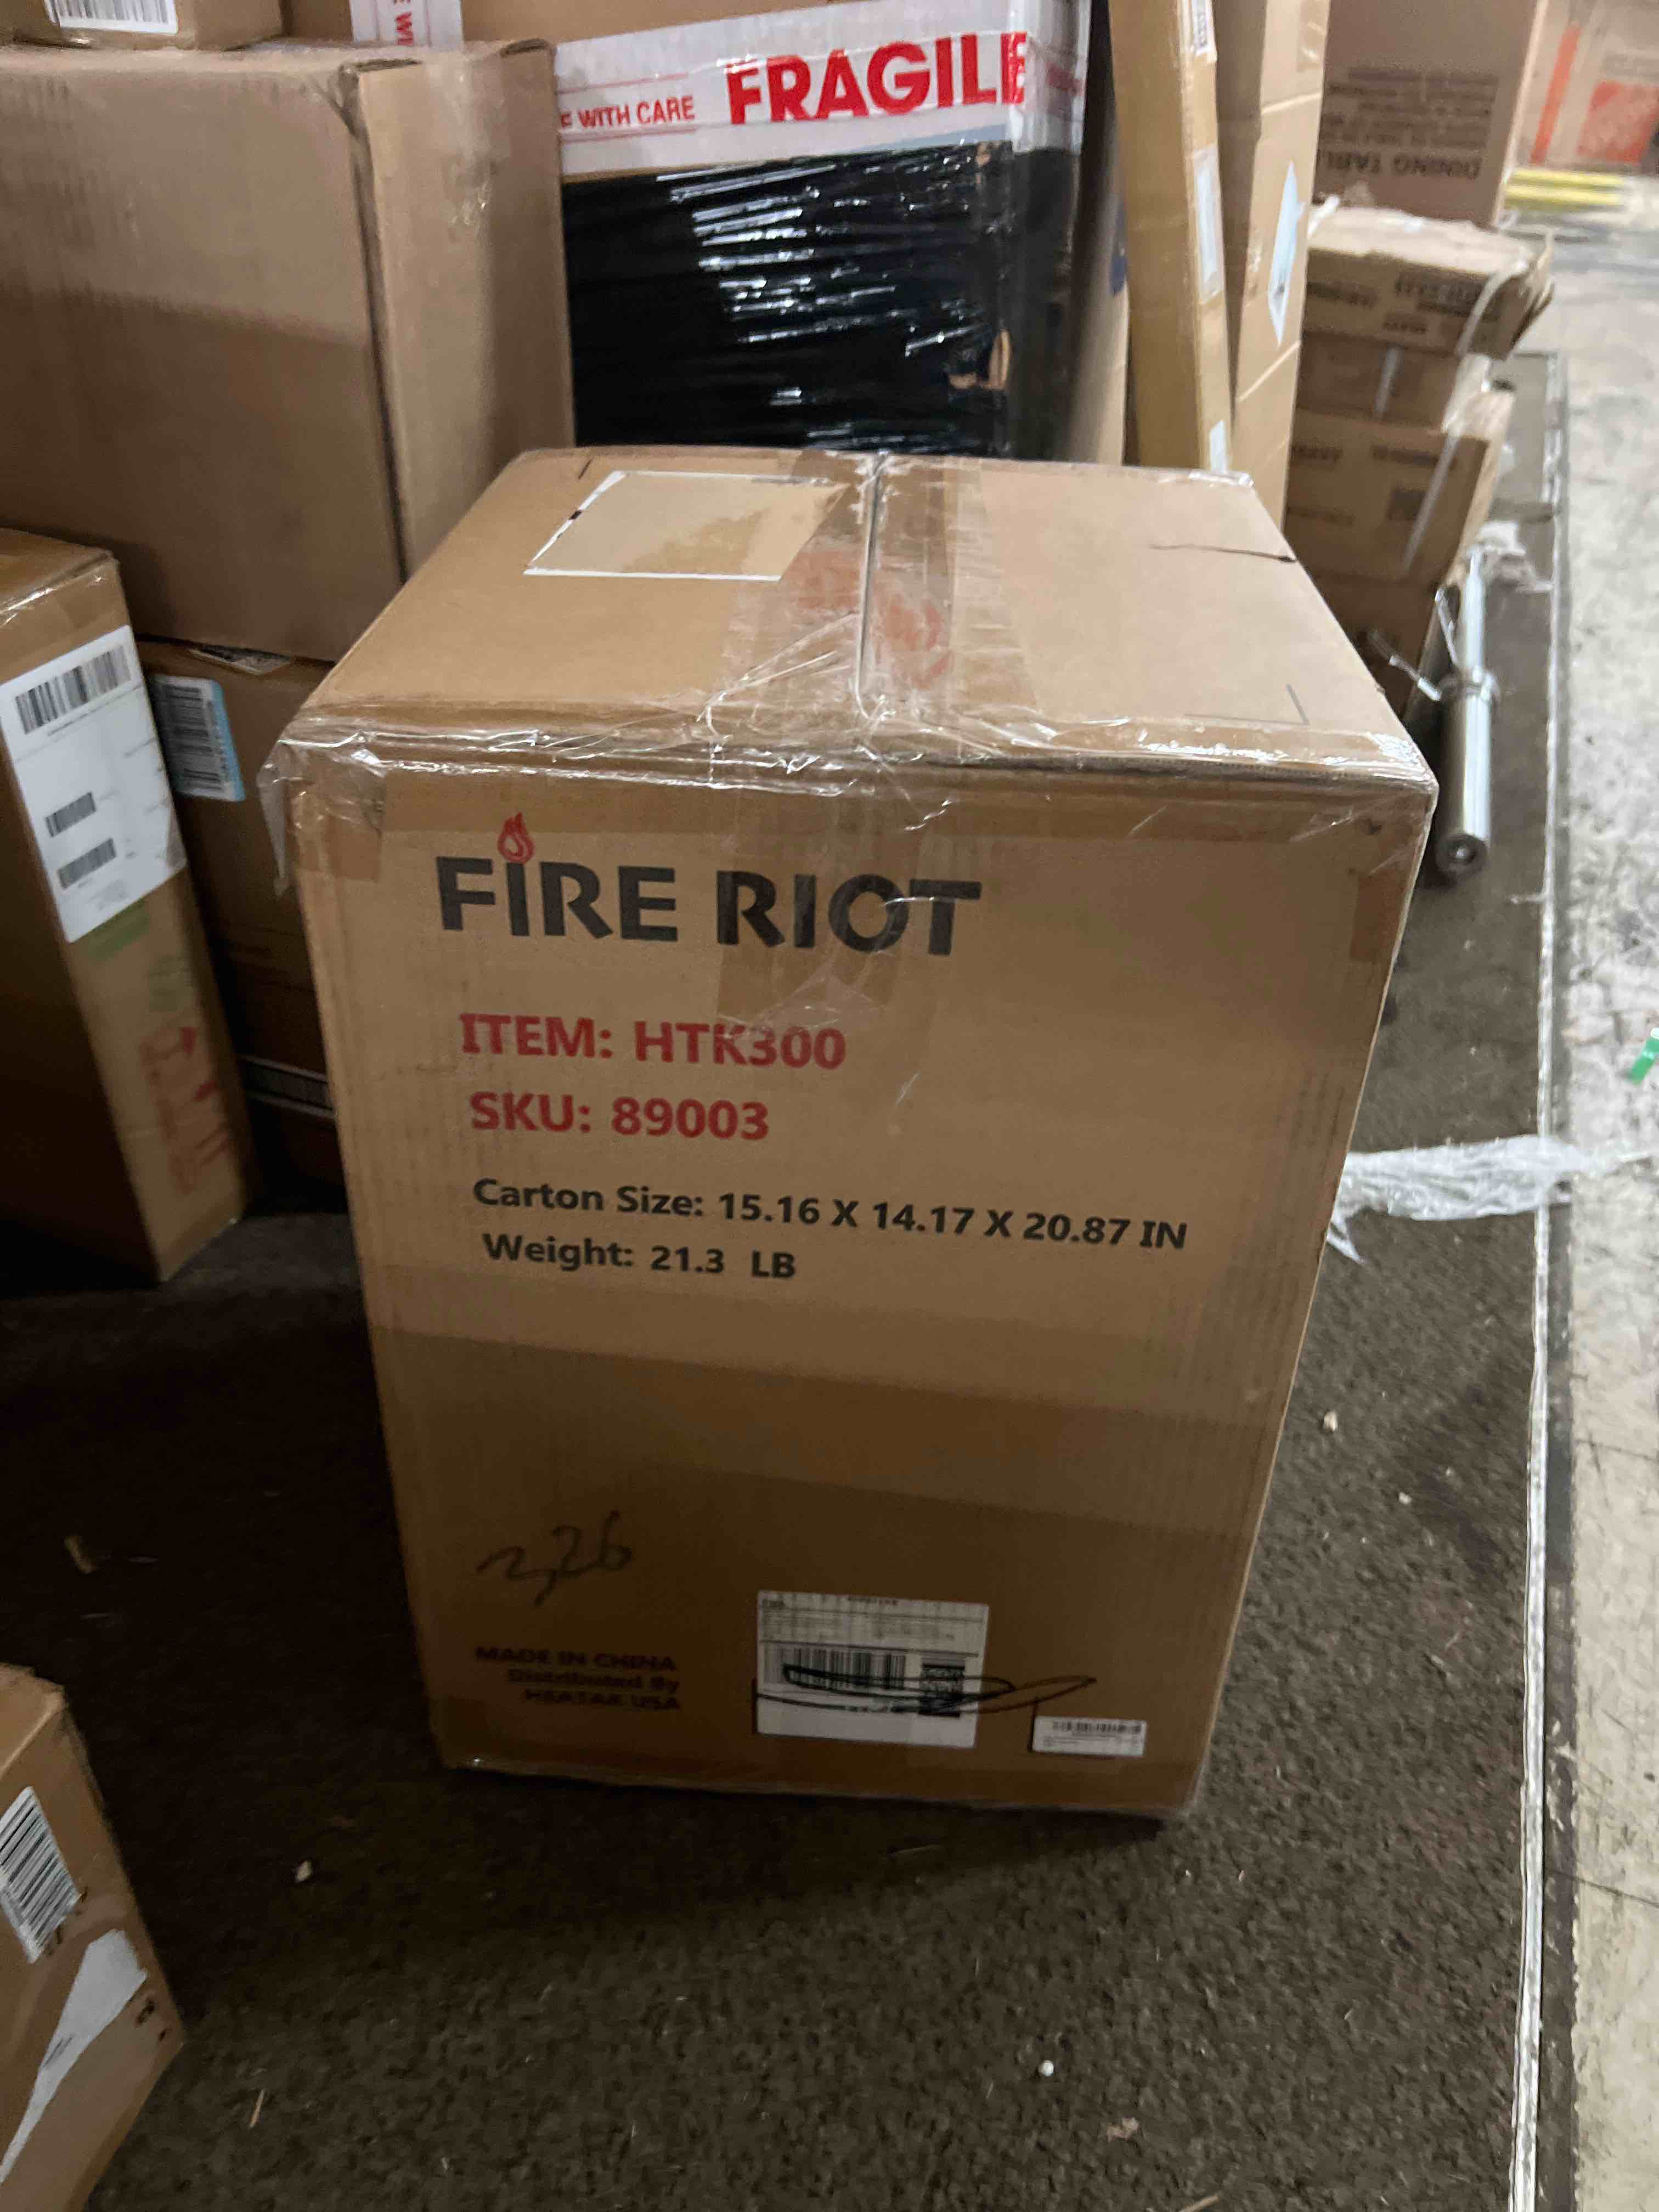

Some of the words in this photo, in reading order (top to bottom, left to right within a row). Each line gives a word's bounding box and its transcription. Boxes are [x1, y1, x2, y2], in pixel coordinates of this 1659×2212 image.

[726, 31, 1028, 125] FRAGILE
[578, 102, 630, 128] WITH
[636, 94, 695, 123] CARE
[436, 855, 678, 942] FIRE
[716, 870, 981, 956] RIOT
[460, 1013, 613, 1058] ITEM:
[635, 1021, 845, 1069] HTK300
[470, 1092, 591, 1133] SKU:
[611, 1097, 769, 1140] 89003
[473, 1178, 604, 1211] Carton
[616, 1185, 704, 1217] Size:
[718, 1193, 820, 1225] 15.16
[830, 1199, 859, 1228] X
[872, 1201, 975, 1235] 14.17
[984, 1210, 1014, 1239] X
[1023, 1212, 1131, 1245] 20.87
[1139, 1221, 1188, 1249] IN
[482, 1233, 633, 1272] Weight:
[651, 1245, 725, 1273] 21.3
[751, 1250, 795, 1279] LB
[474, 1646, 550, 1663] MADE
[556, 1650, 586, 1666] IN
[592, 1652, 678, 1671] CHINA
[630, 1695, 681, 1711] USA
